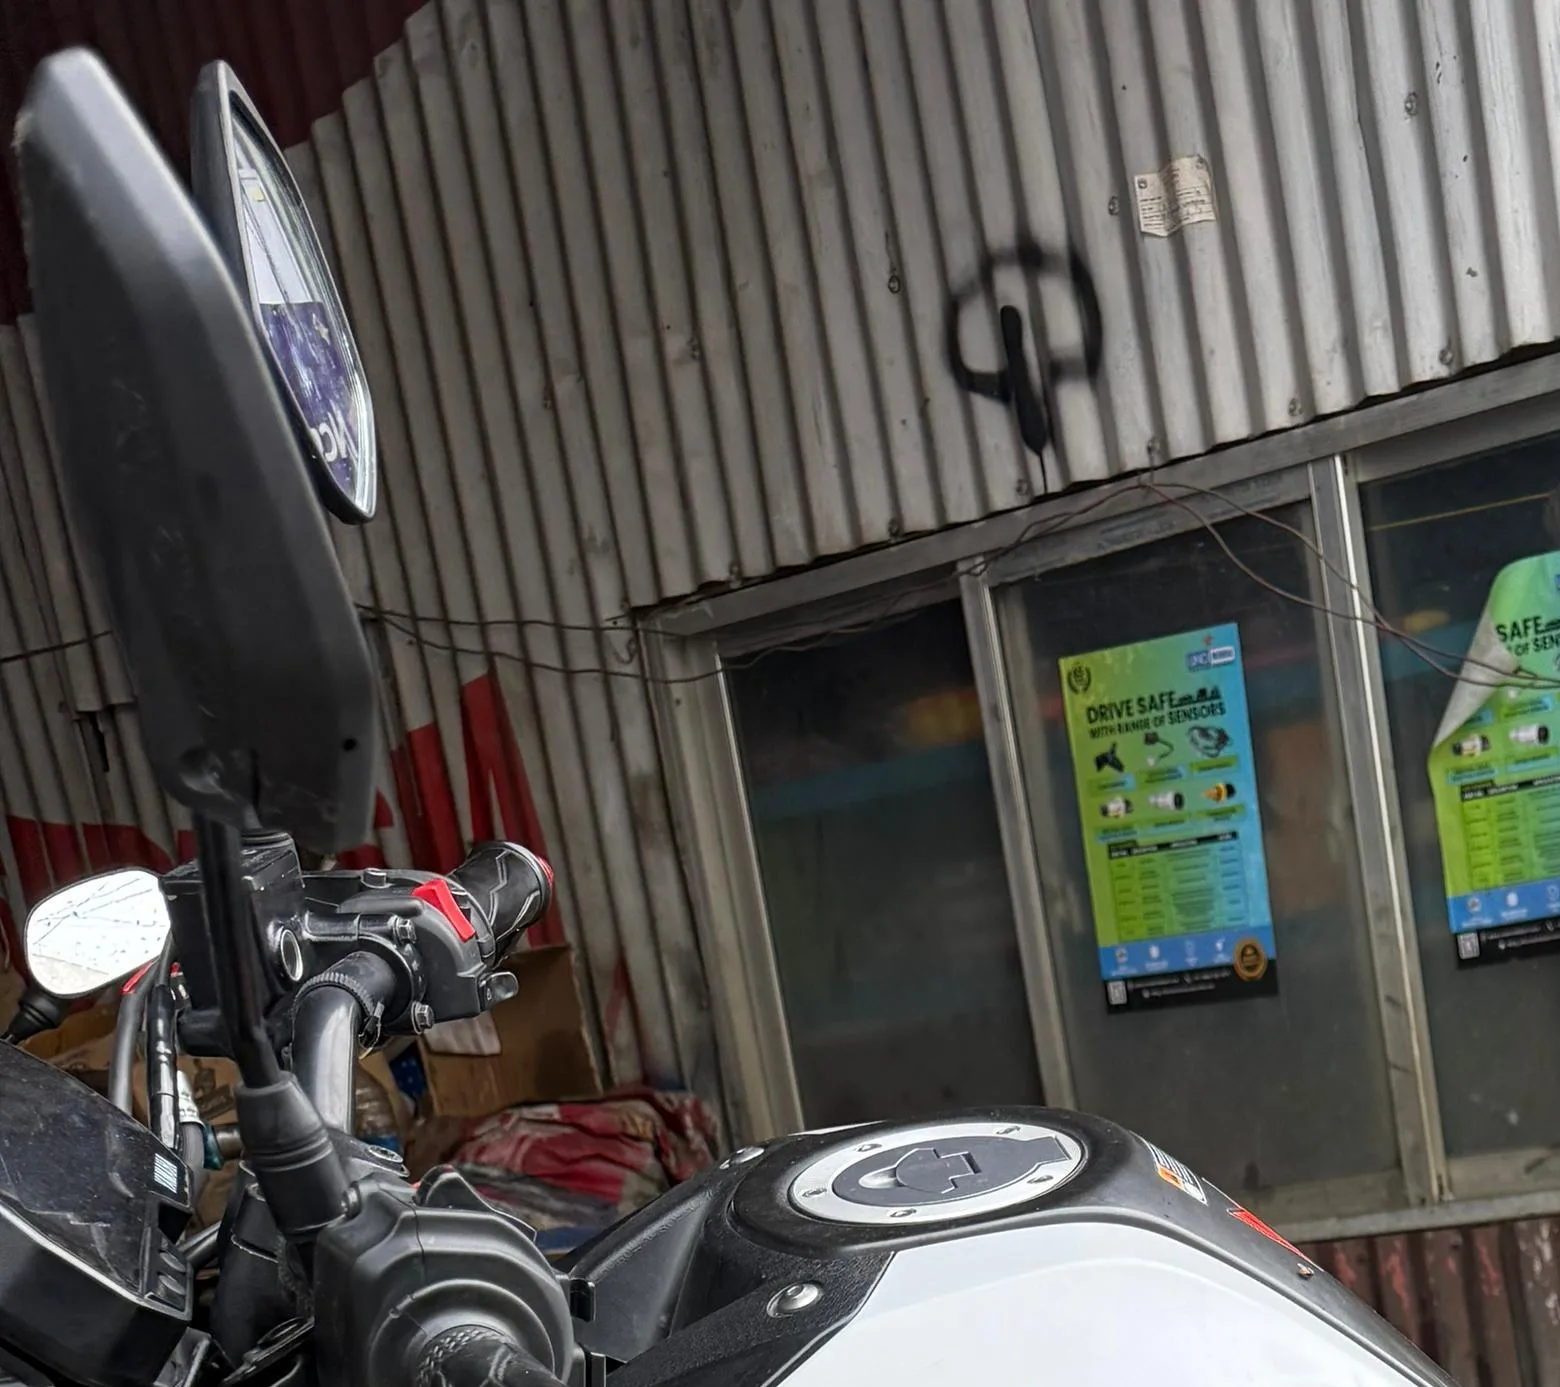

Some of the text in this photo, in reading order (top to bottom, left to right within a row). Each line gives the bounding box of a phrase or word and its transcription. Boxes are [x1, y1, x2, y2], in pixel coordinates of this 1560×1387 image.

[1495, 616, 1542, 642] SAFE
[1086, 690, 1176, 724] DRIVE SAFE
[1167, 702, 1226, 725] SENSORS
